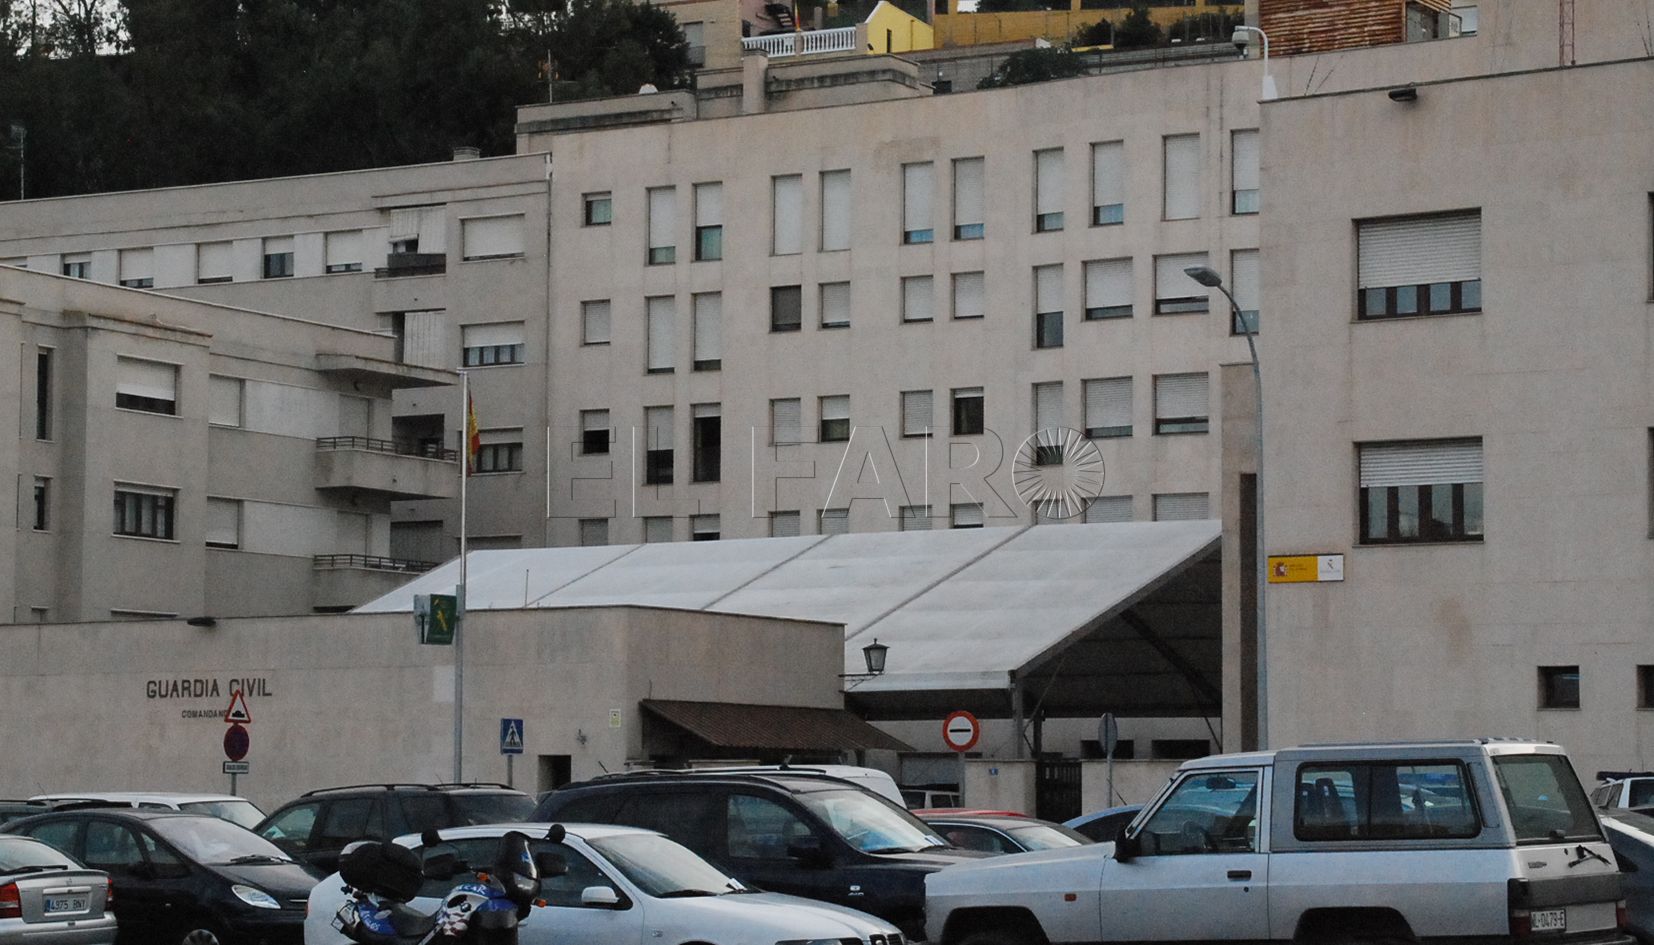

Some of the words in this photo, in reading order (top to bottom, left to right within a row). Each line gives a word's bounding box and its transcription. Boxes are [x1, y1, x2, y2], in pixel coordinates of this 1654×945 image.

[146, 679, 220, 698] GUARDIA
[229, 678, 272, 697] CIVIL
[182, 709, 228, 718] COMANDANC
